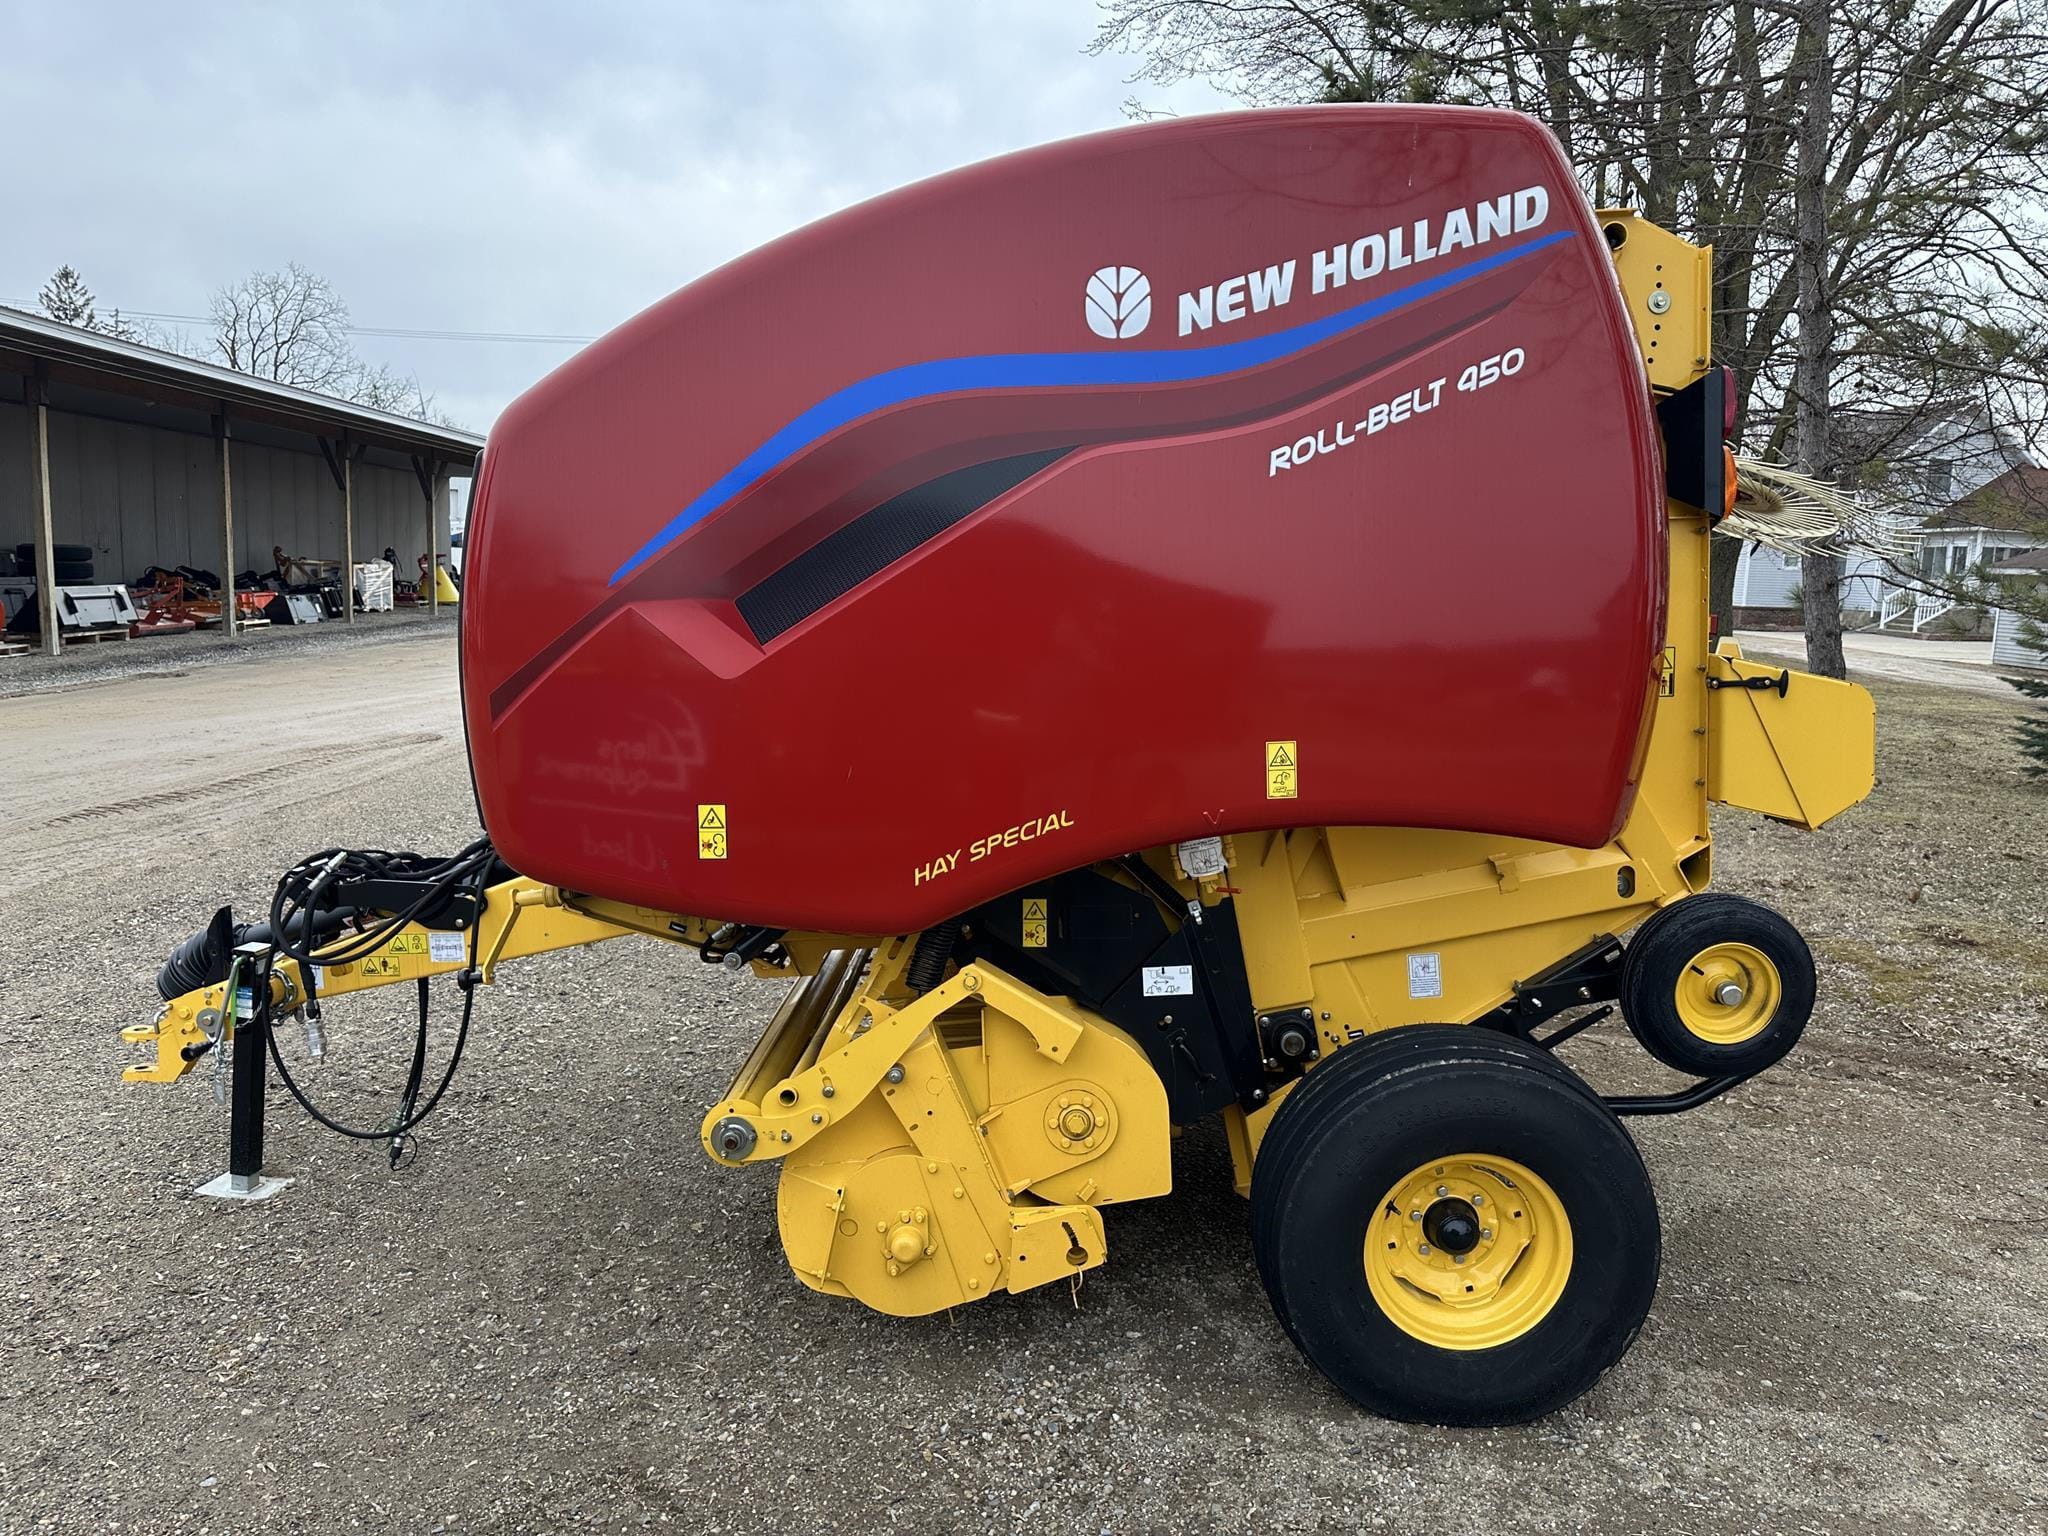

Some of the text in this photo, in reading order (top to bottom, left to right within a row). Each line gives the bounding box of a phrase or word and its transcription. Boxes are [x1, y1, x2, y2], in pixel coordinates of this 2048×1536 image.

[1179, 185, 1549, 336] NEW HOLLAND
[1269, 348, 1525, 477] ROLL-BELT 450
[914, 810, 1074, 887] HAY SPECIAL
